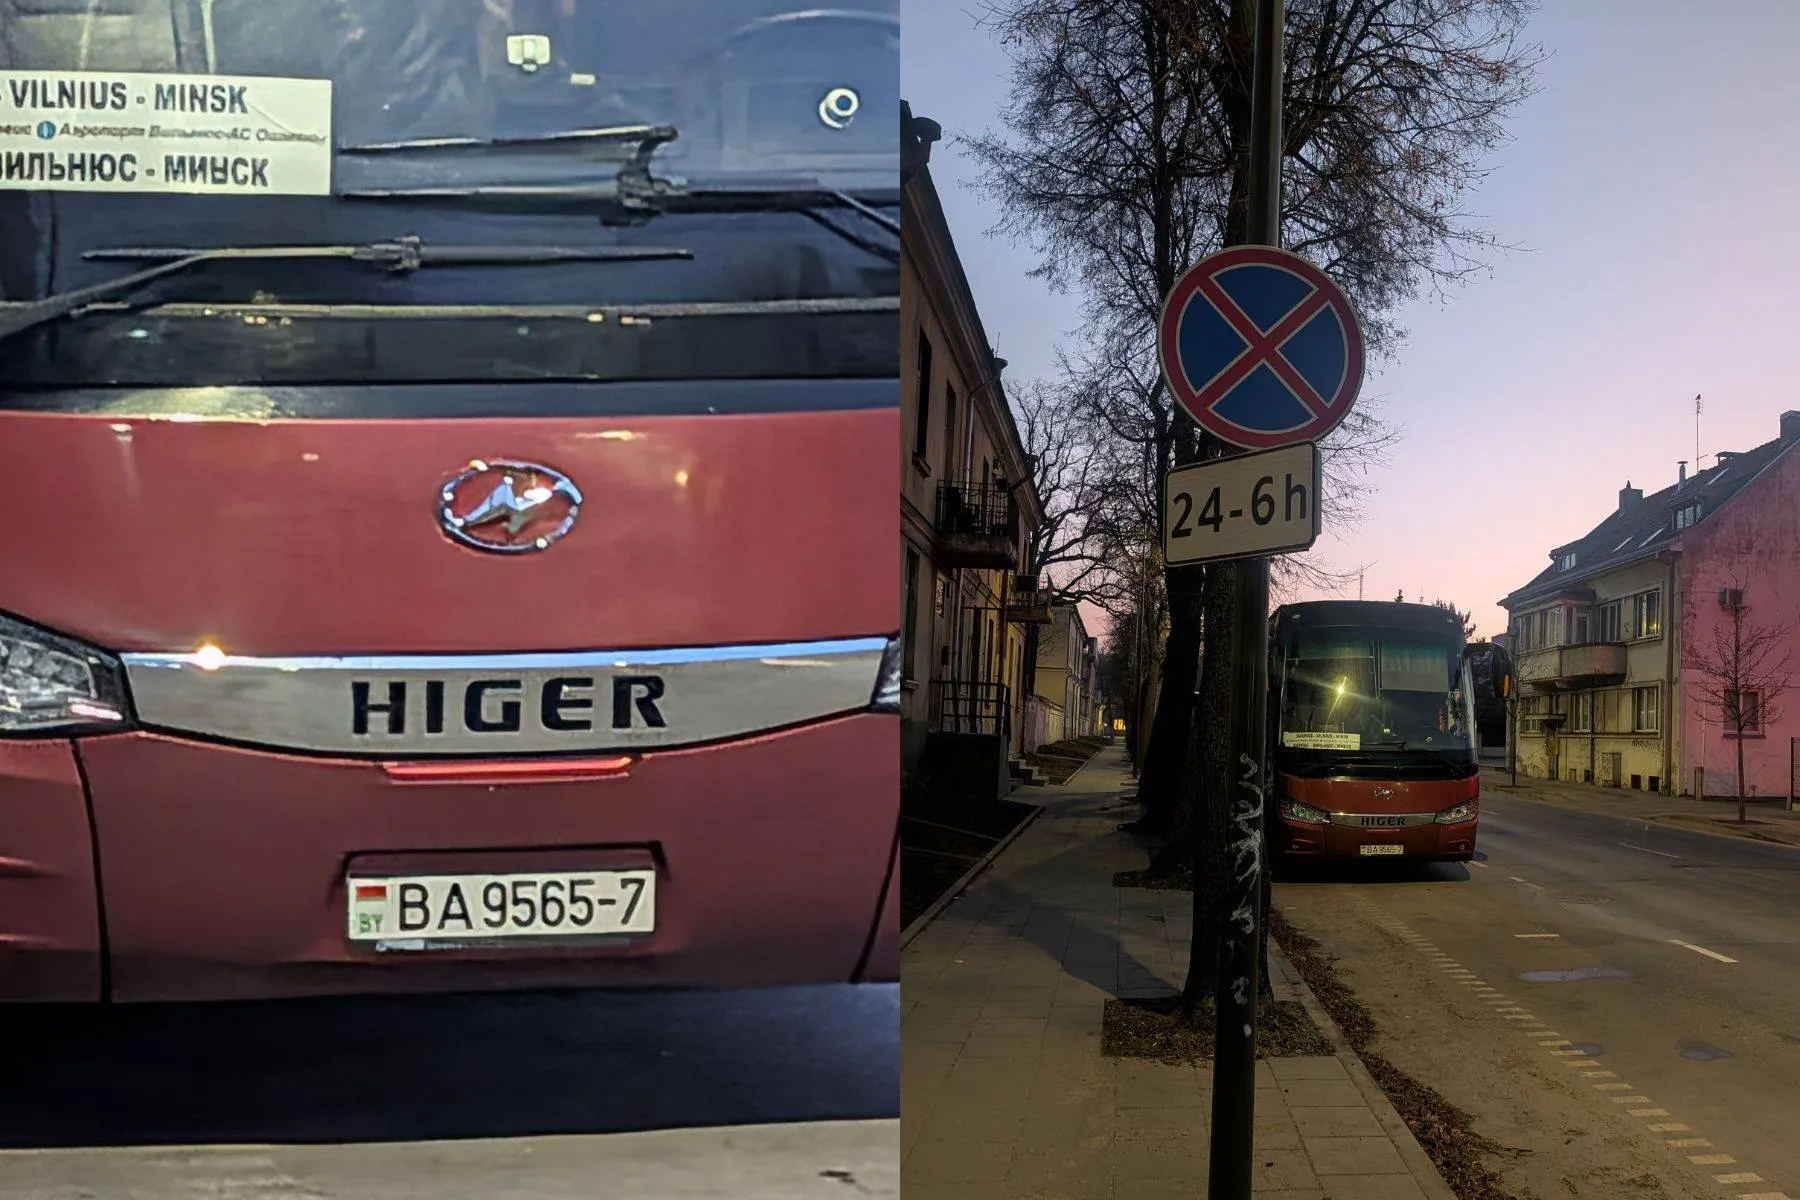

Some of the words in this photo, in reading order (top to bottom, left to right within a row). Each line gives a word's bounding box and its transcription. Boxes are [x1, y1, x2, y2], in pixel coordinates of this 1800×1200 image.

[9, 78, 127, 110] VILNIUS
[154, 83, 249, 114] MINSK
[0, 151, 137, 182] ИЛЬНЮС
[352, 674, 668, 734] HIGER
[1361, 817, 1405, 826] HIGER
[358, 912, 384, 933] BY
